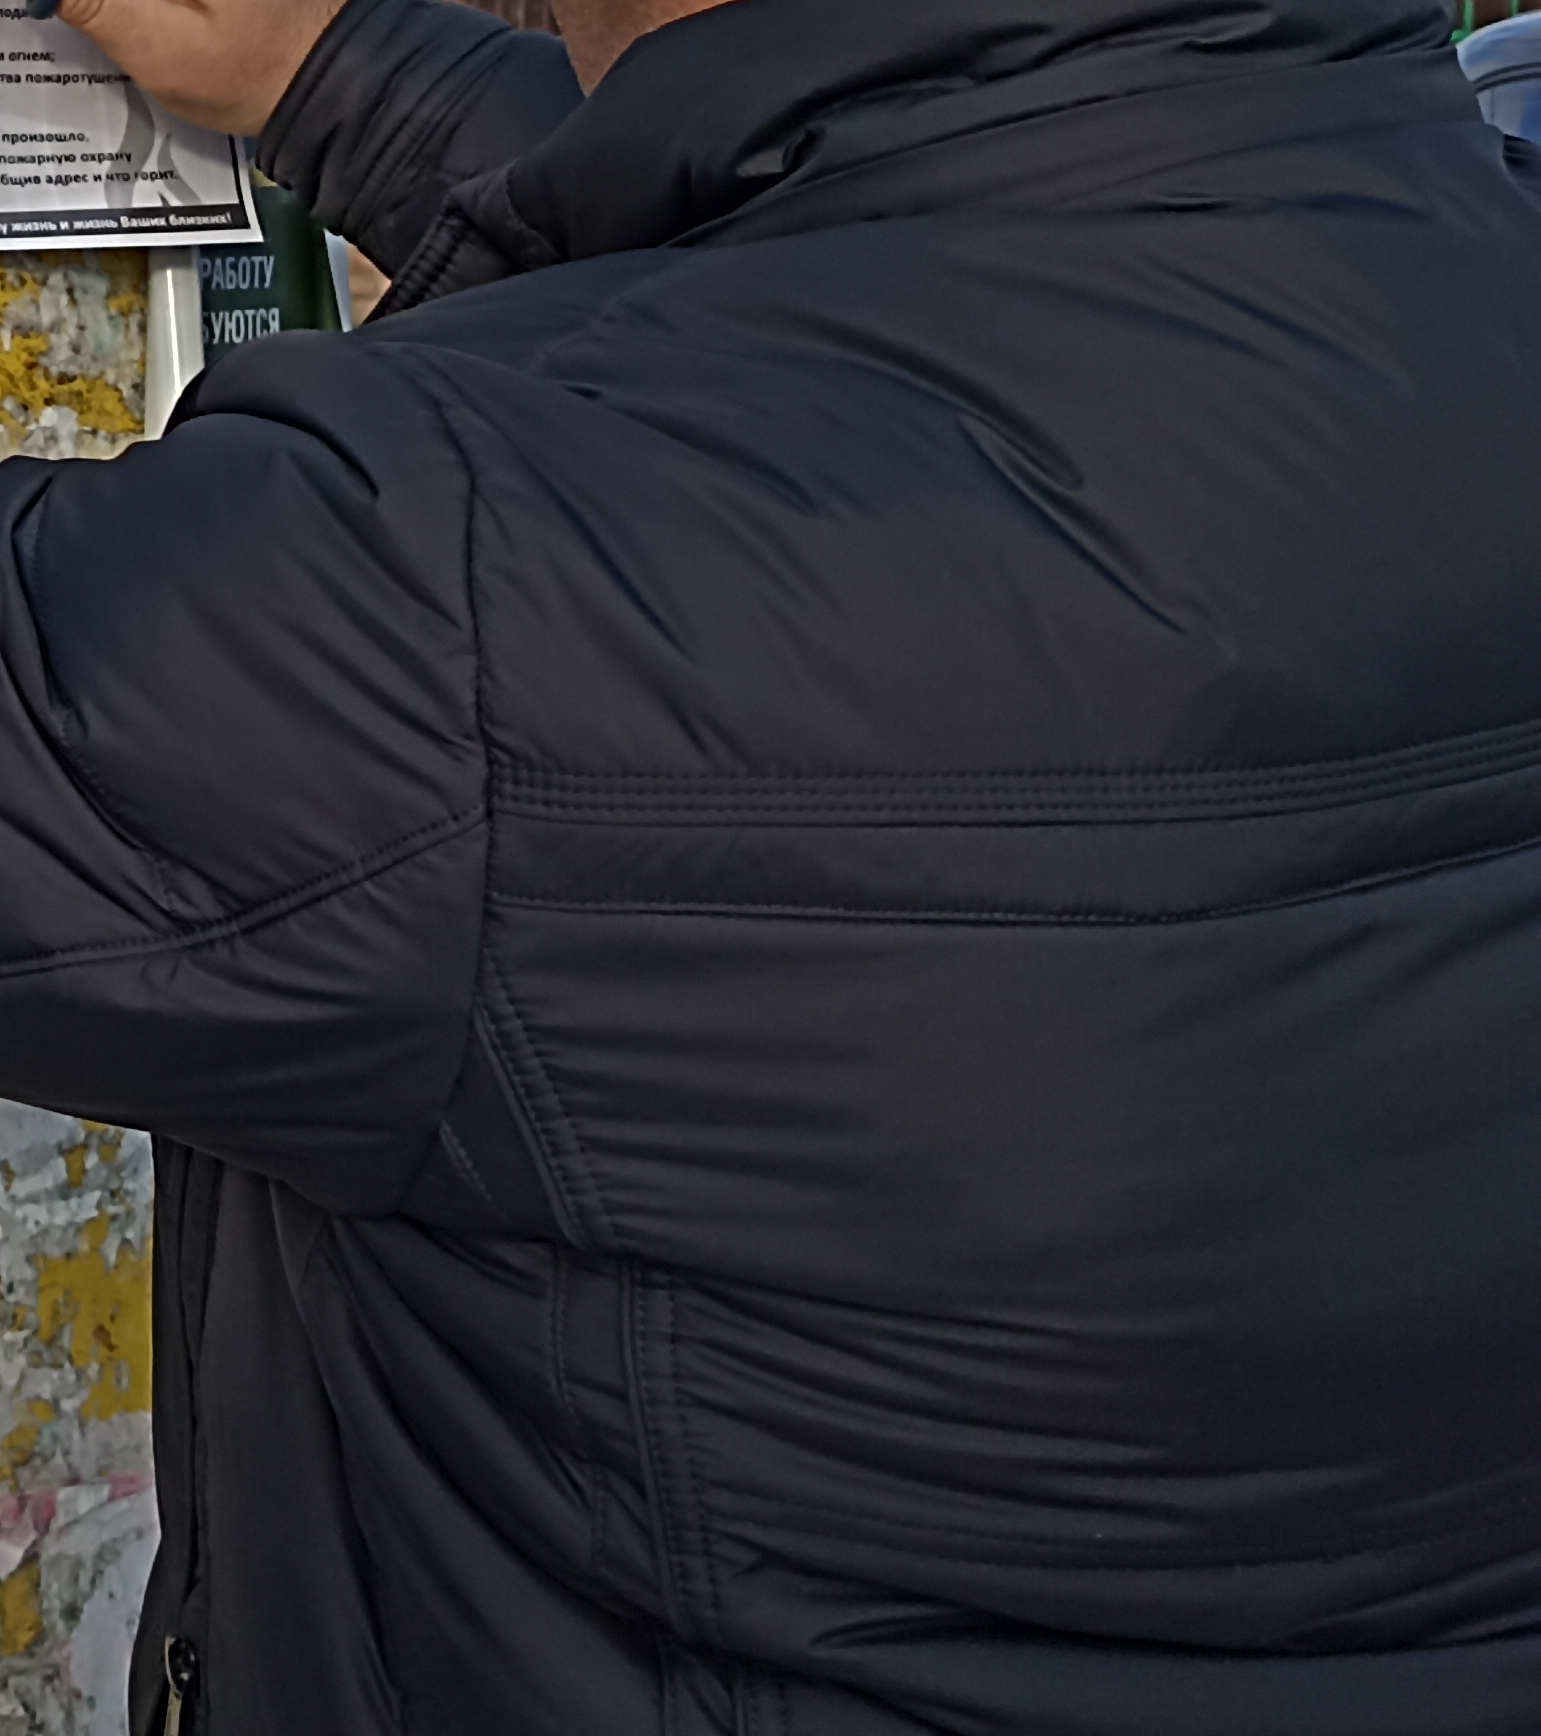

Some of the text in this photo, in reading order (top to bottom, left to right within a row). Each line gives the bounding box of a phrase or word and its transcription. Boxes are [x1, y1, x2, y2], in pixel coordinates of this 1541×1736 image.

[80, 151, 133, 166] охрану
[45, 172, 89, 188] адрес
[92, 173, 103, 184] и
[106, 172, 131, 183] что
[11, 220, 57, 234] жизнь
[72, 217, 118, 231] жизнь
[121, 214, 167, 229] Ваших
[199, 253, 275, 290] РАБОТУ
